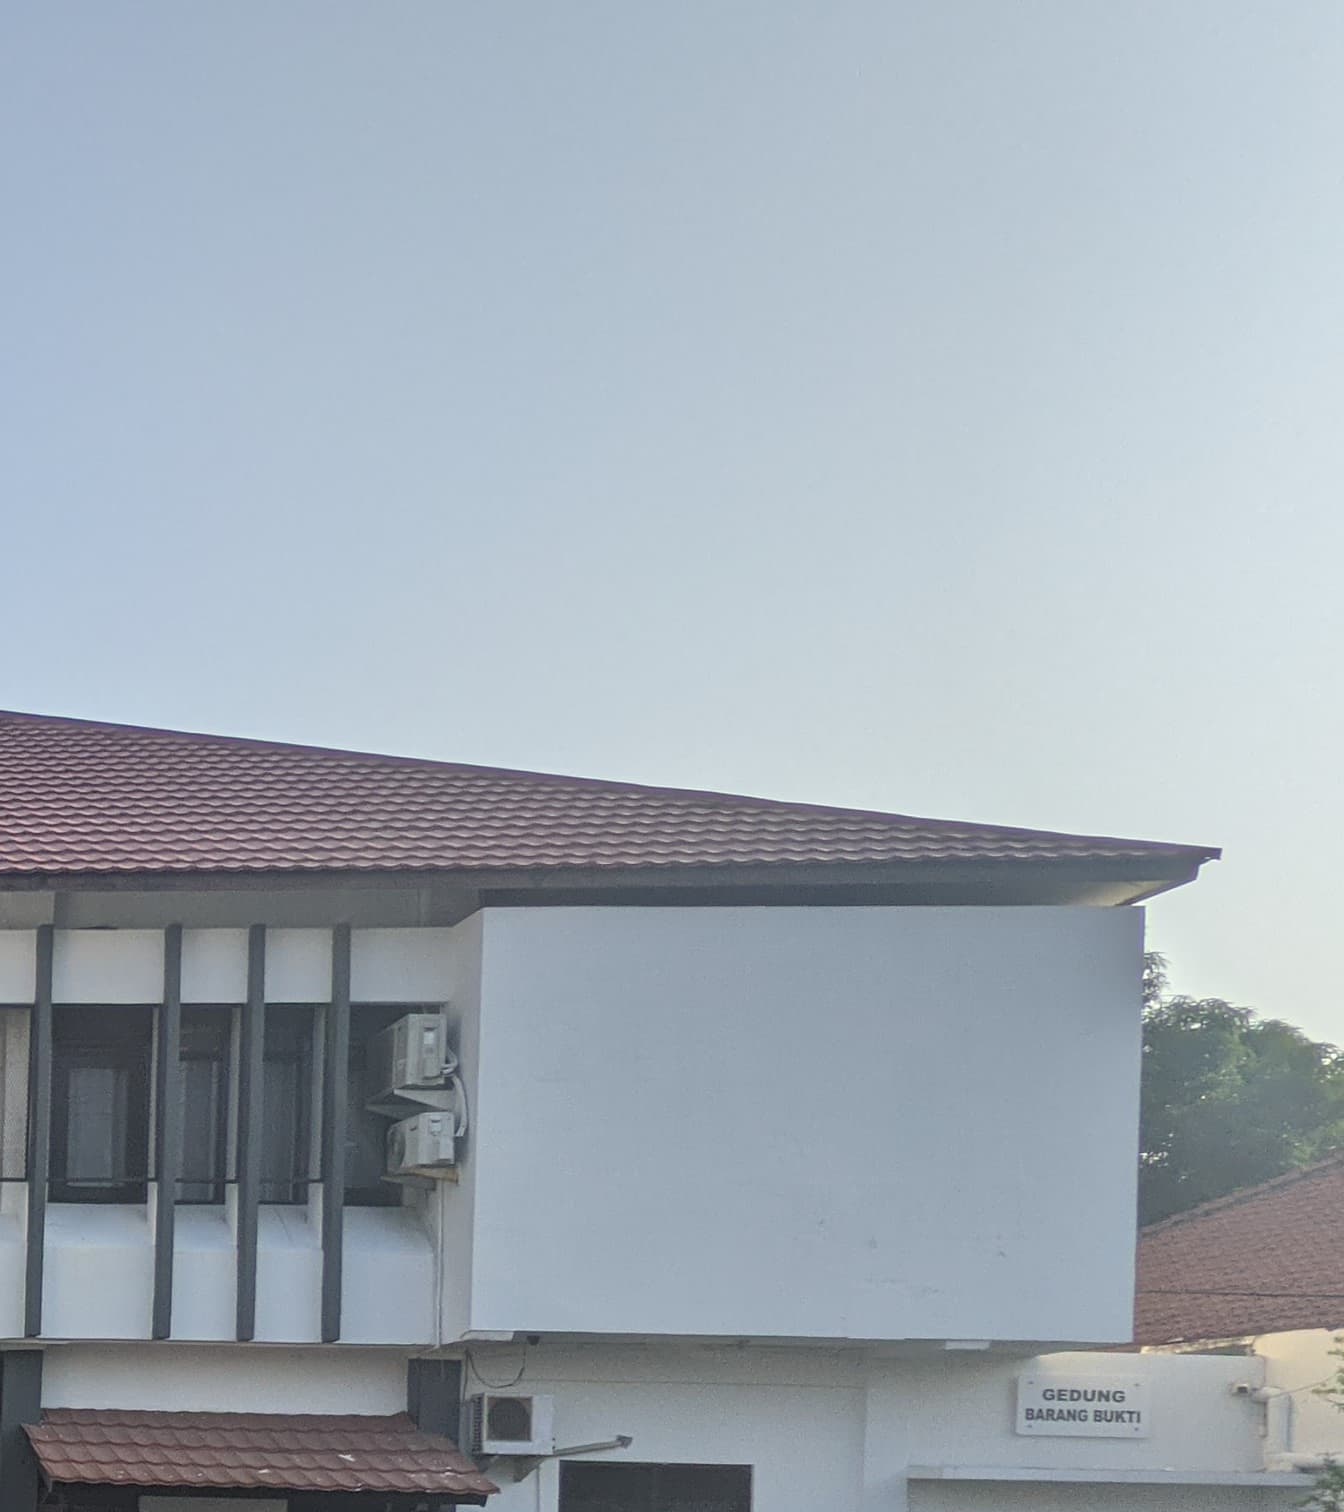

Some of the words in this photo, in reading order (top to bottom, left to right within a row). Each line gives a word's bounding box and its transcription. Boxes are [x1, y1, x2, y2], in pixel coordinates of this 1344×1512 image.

[1042, 1388, 1126, 1403] GEDUNG
[1025, 1408, 1089, 1422] BARANG
[1093, 1409, 1141, 1423] BUKTI
